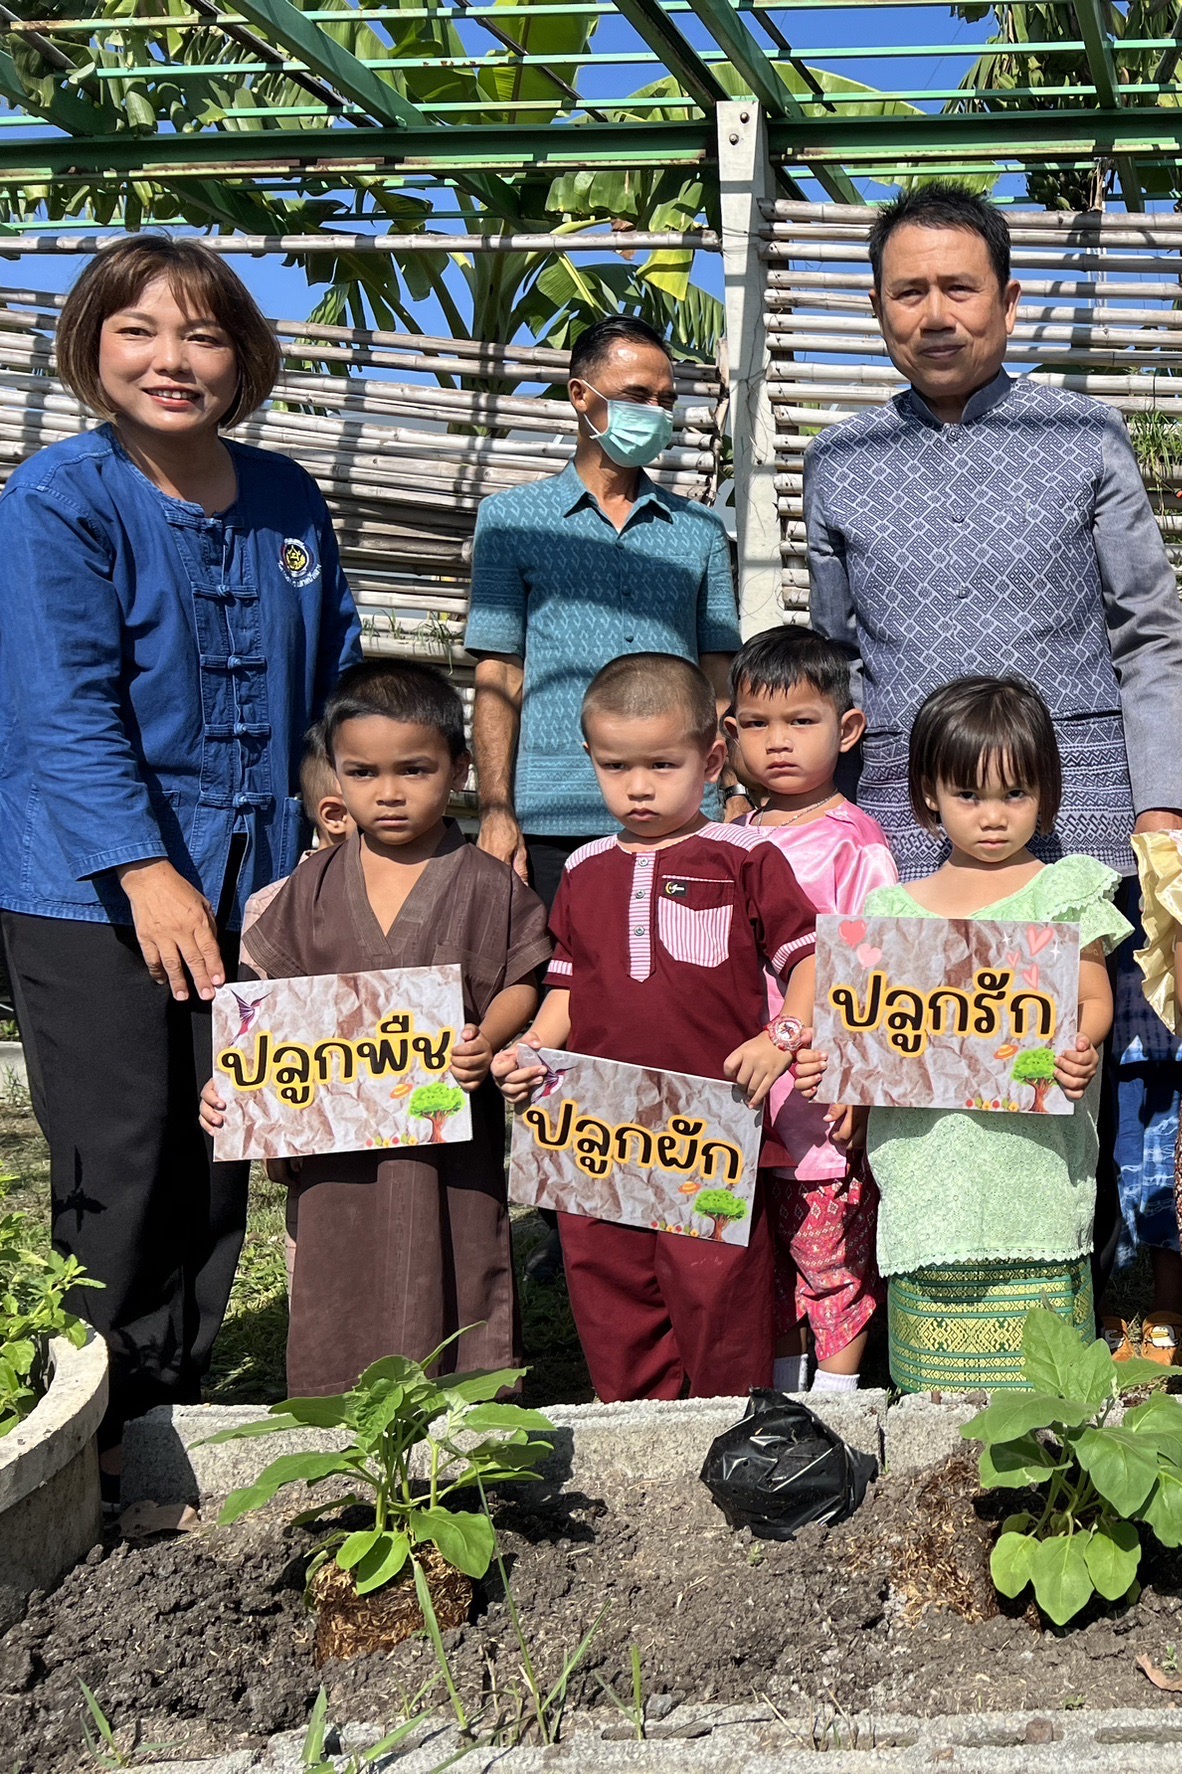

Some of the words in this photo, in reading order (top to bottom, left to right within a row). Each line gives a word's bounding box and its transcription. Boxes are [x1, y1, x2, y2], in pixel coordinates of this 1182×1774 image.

[832, 972, 1051, 1053] ปลูกรัก
[221, 1014, 451, 1104] ปลูกพืช
[527, 1103, 739, 1180] ปลูกผัก
